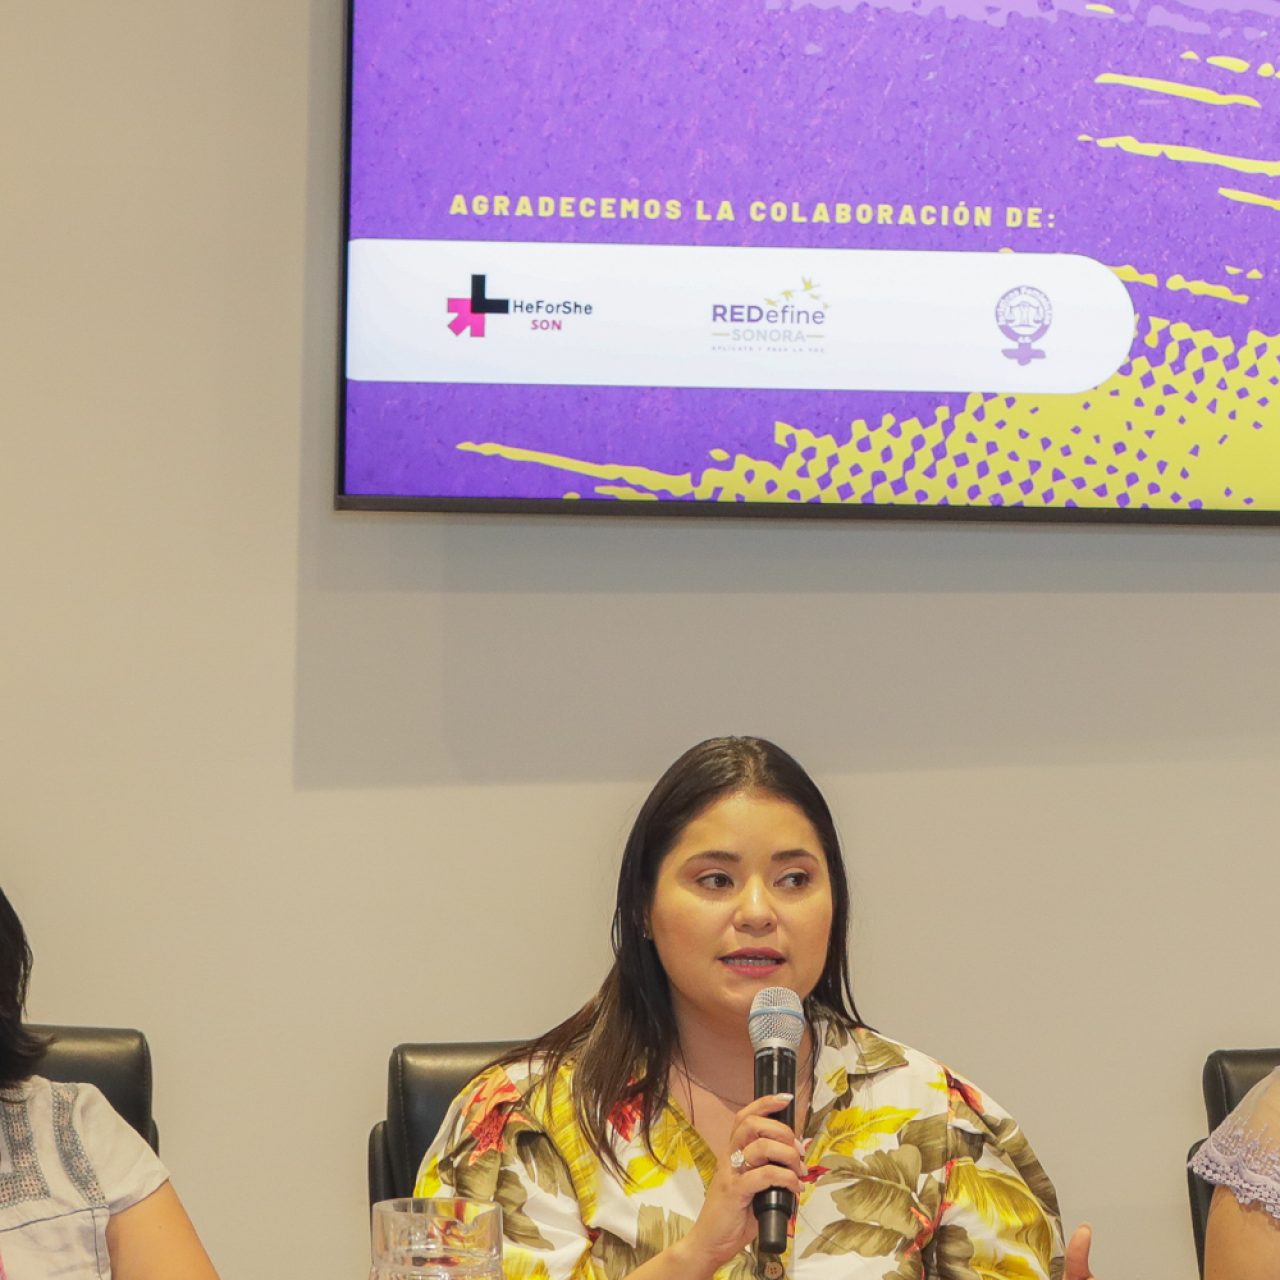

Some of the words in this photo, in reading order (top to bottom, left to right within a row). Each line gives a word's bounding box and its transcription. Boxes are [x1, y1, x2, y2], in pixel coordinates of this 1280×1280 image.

[449, 194, 682, 219] AGRADECEMOS
[696, 200, 735, 221] LA
[750, 201, 991, 226] COLABORACIÓN
[1006, 207, 1056, 228] DE:
[513, 300, 593, 315] HeForShe
[712, 304, 825, 324] REDefine
[531, 319, 562, 331] SON
[732, 329, 806, 342] SONORA
